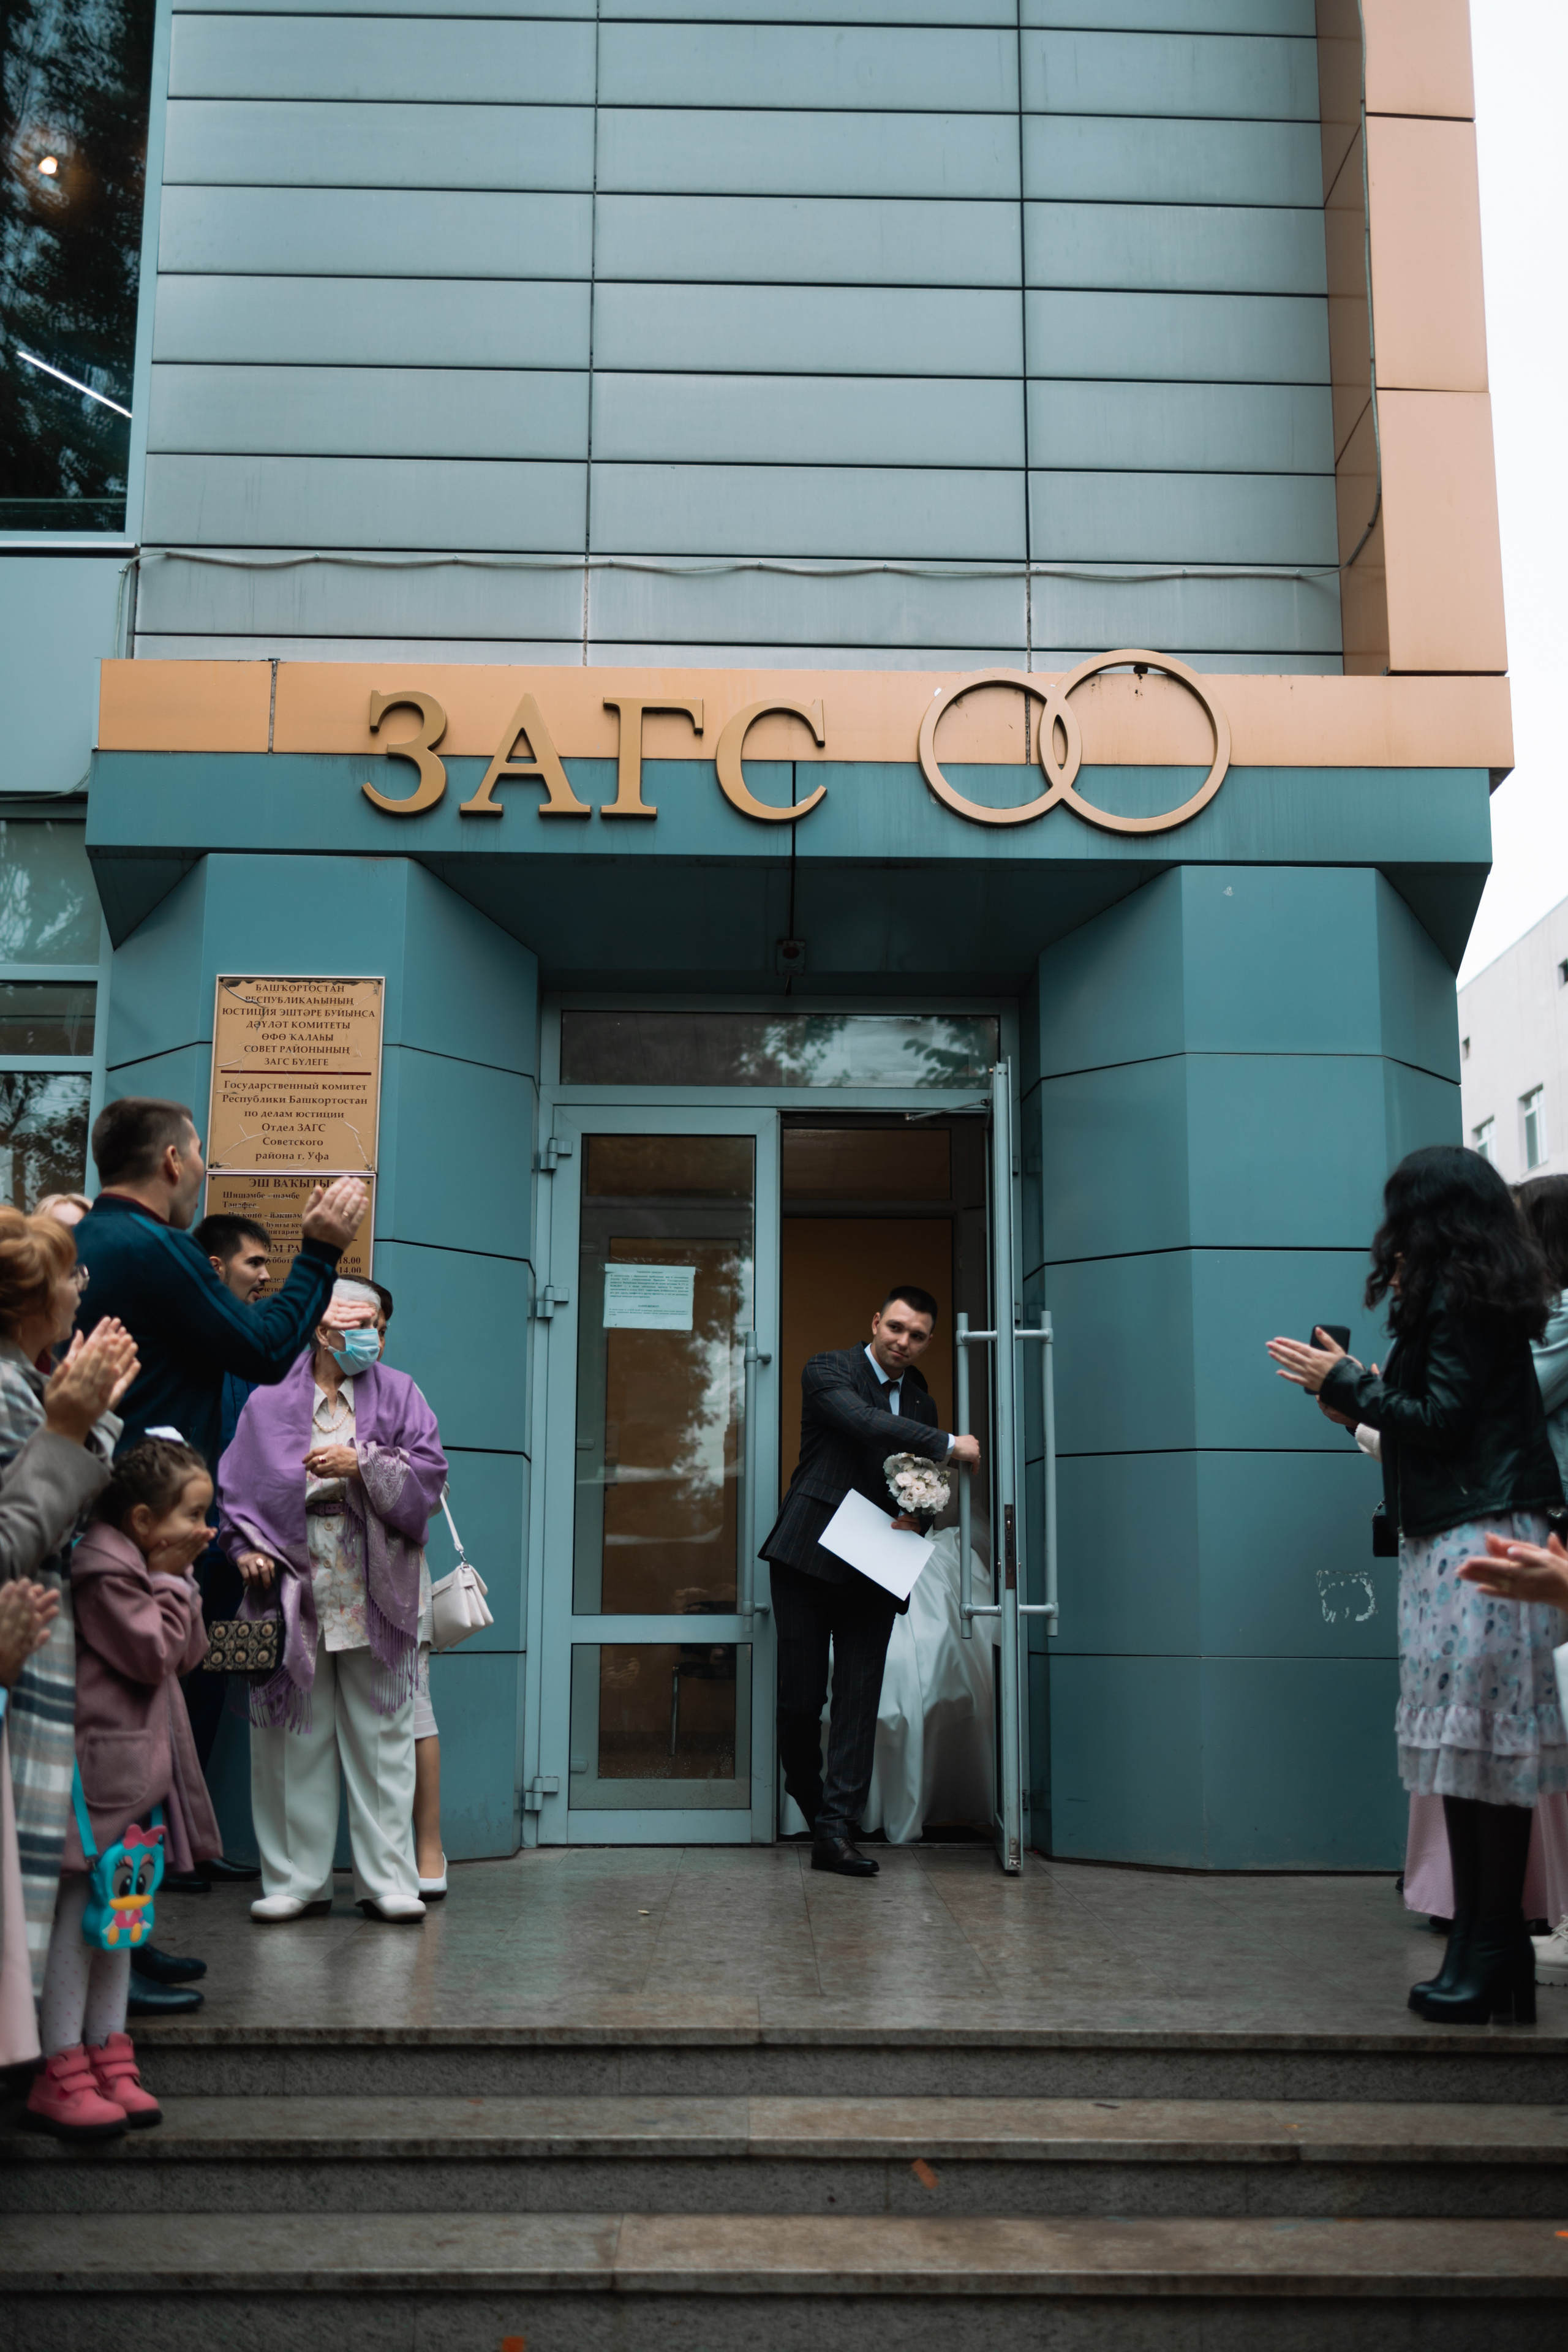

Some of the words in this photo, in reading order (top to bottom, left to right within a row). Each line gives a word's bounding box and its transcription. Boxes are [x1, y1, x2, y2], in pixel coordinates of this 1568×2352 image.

[361, 690, 827, 823] ЗАГС
[222, 1008, 276, 1017] ЮСТИЦИЯ
[325, 1008, 375, 1017] БУЙЫНСА
[292, 1021, 350, 1030] КОМИТЕТЫ
[279, 1044, 350, 1055] РАЙОНЫНЫҢ
[224, 1080, 318, 1093] Государственный
[222, 1095, 285, 1105] Республики
[289, 1096, 368, 1106] Башкортостан
[262, 1123, 294, 1133] Отдел
[297, 1123, 326, 1132] ЗАГС
[263, 1137, 323, 1146] Советского
[255, 1152, 294, 1161] района
[307, 1152, 329, 1163] Уфа
[249, 1178, 269, 1188] ЭШ
